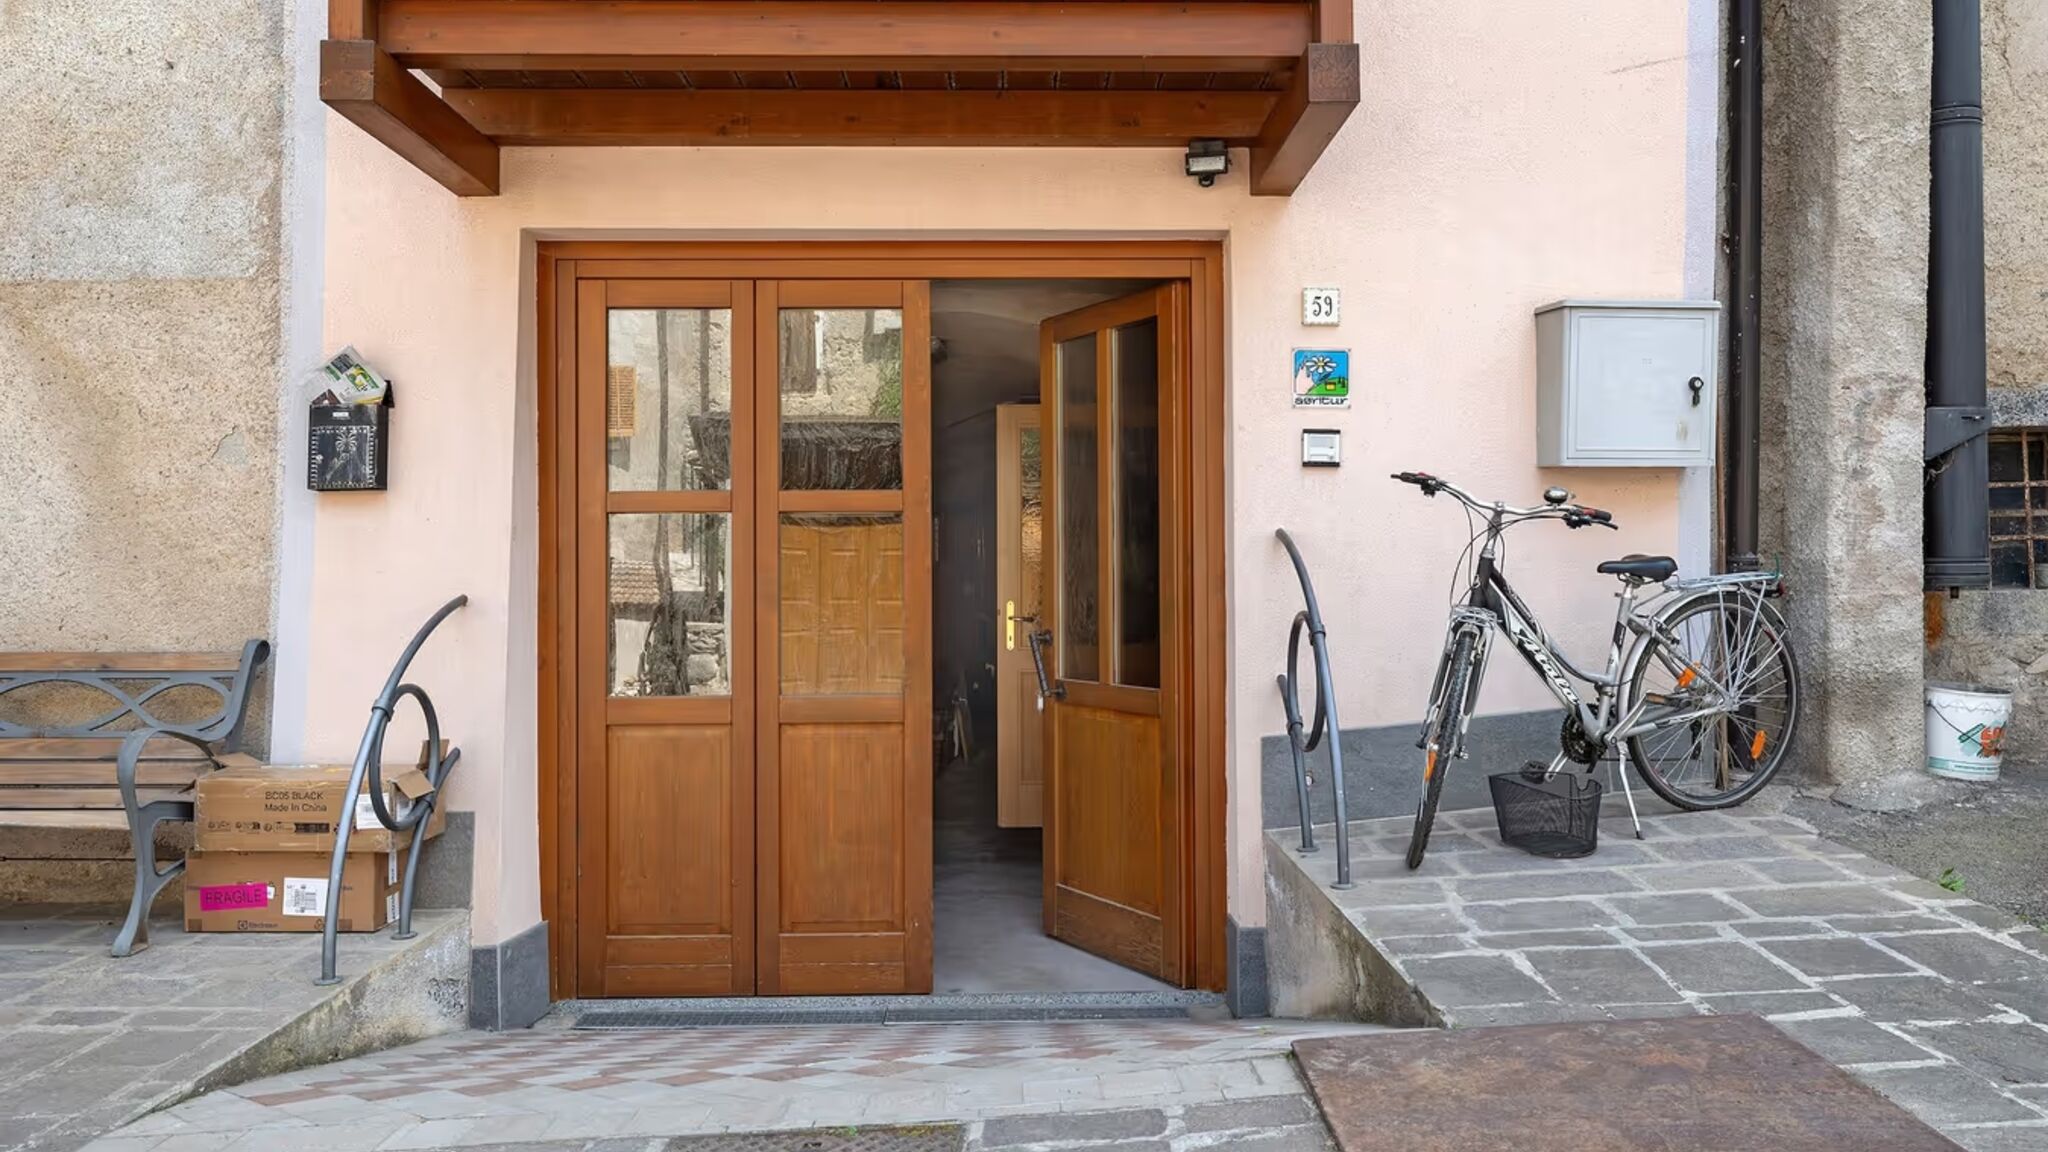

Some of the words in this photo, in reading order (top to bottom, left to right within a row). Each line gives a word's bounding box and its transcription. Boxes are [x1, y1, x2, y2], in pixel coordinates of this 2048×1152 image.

[1312, 295, 1333, 317] 59
[265, 791, 290, 800] BC05
[291, 791, 324, 800] BLACK
[264, 803, 289, 812] Made
[302, 803, 327, 812] China
[205, 888, 262, 905] FRAGILE
